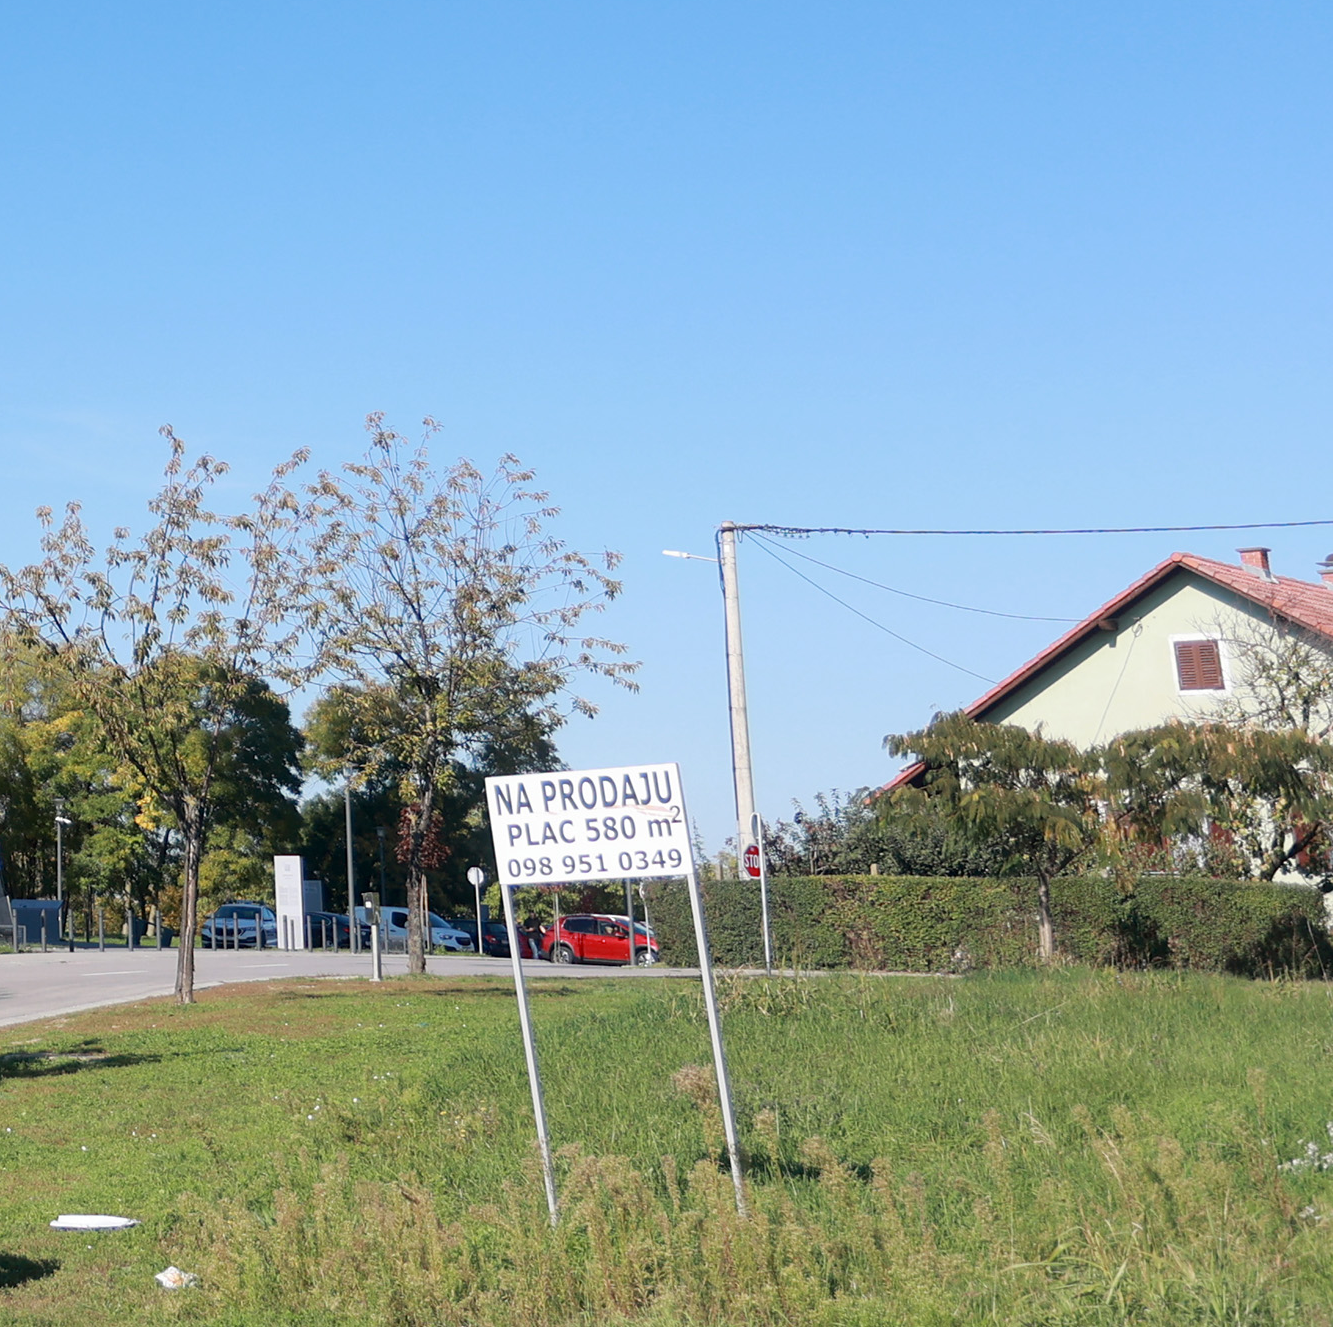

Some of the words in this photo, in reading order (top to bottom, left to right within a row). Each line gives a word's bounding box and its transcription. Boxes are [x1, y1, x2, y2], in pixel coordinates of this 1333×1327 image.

[494, 783, 533, 816] NA
[541, 771, 672, 812] PRODAJU
[507, 820, 576, 847] PLAC
[586, 815, 636, 842] 580
[508, 857, 554, 878] 098
[562, 853, 608, 874] 951
[619, 848, 682, 871] 0349
[744, 854, 760, 868] STO
